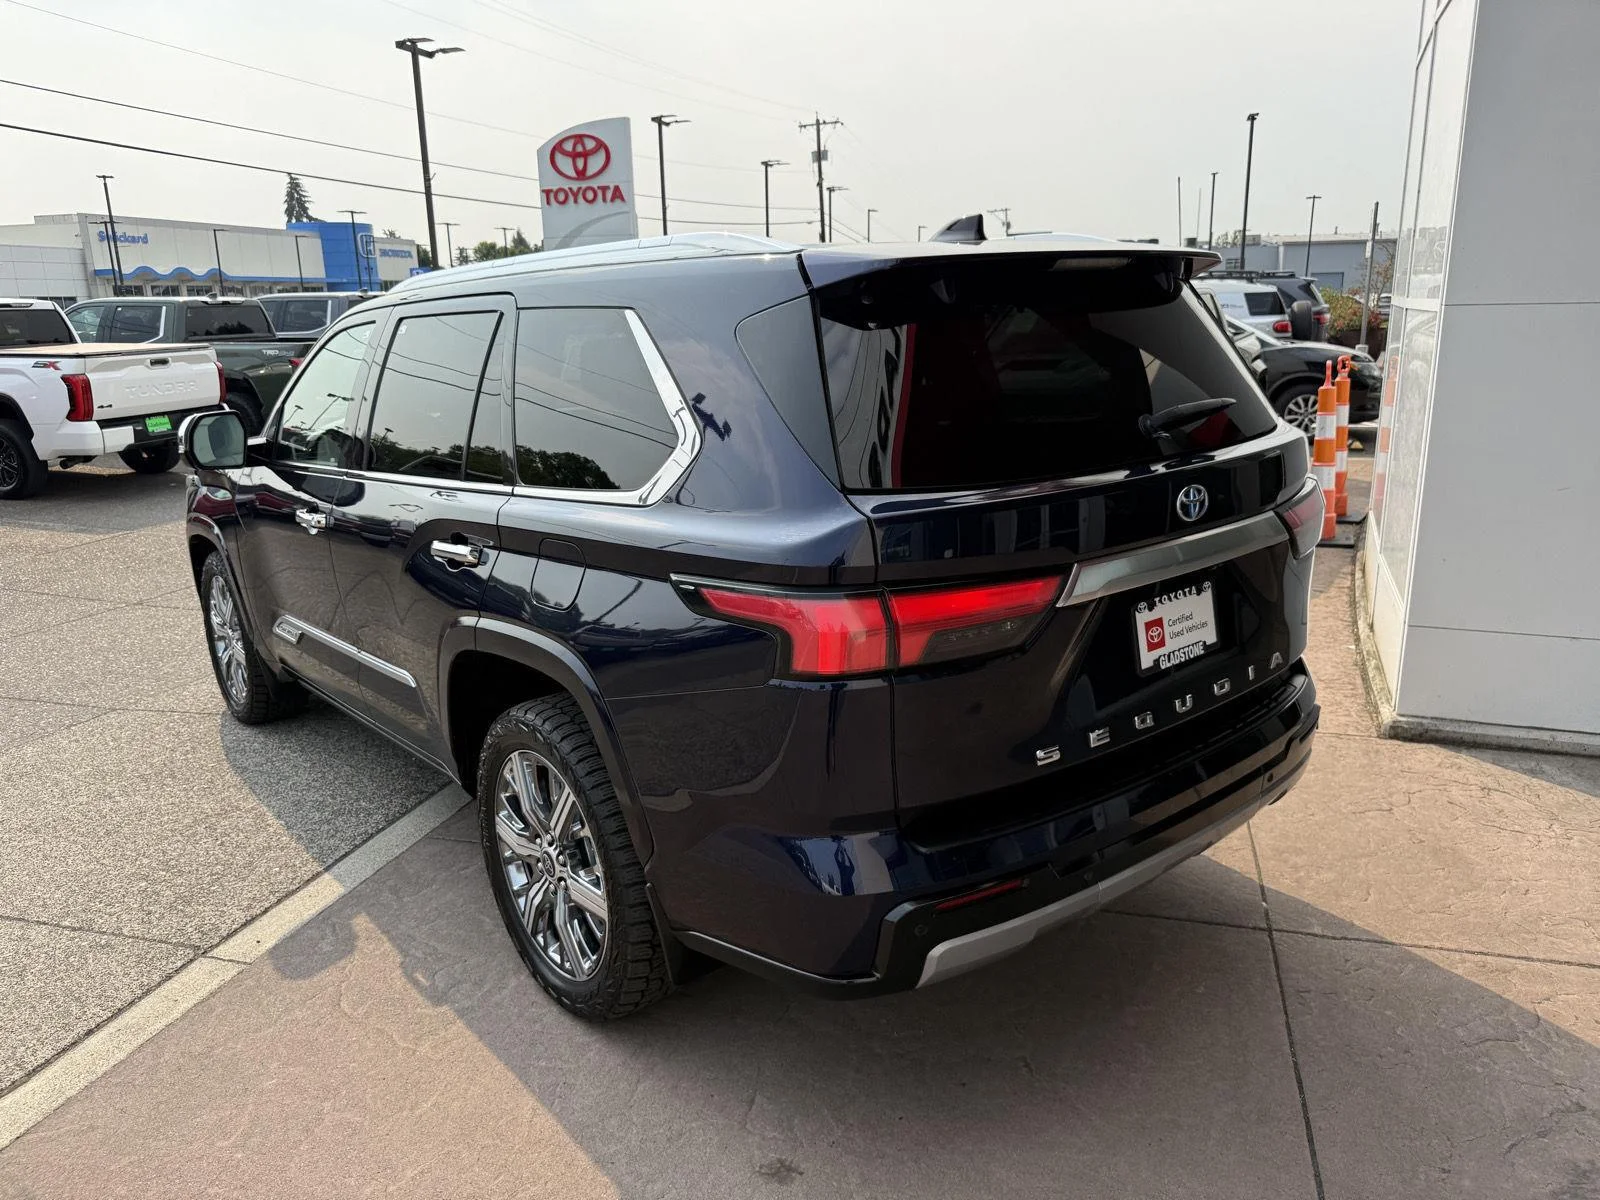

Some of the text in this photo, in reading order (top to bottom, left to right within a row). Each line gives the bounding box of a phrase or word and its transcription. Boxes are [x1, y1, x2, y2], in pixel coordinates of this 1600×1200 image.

[541, 184, 626, 206] TOYOTA
[124, 379, 200, 399] TUNDRA
[1153, 585, 1198, 607] TOYOTA
[1167, 612, 1193, 627] Certified
[1169, 620, 1208, 640] Used Vehicles
[1159, 641, 1205, 669] GLADSTONE
[1035, 652, 1284, 767] SEQUOIA
